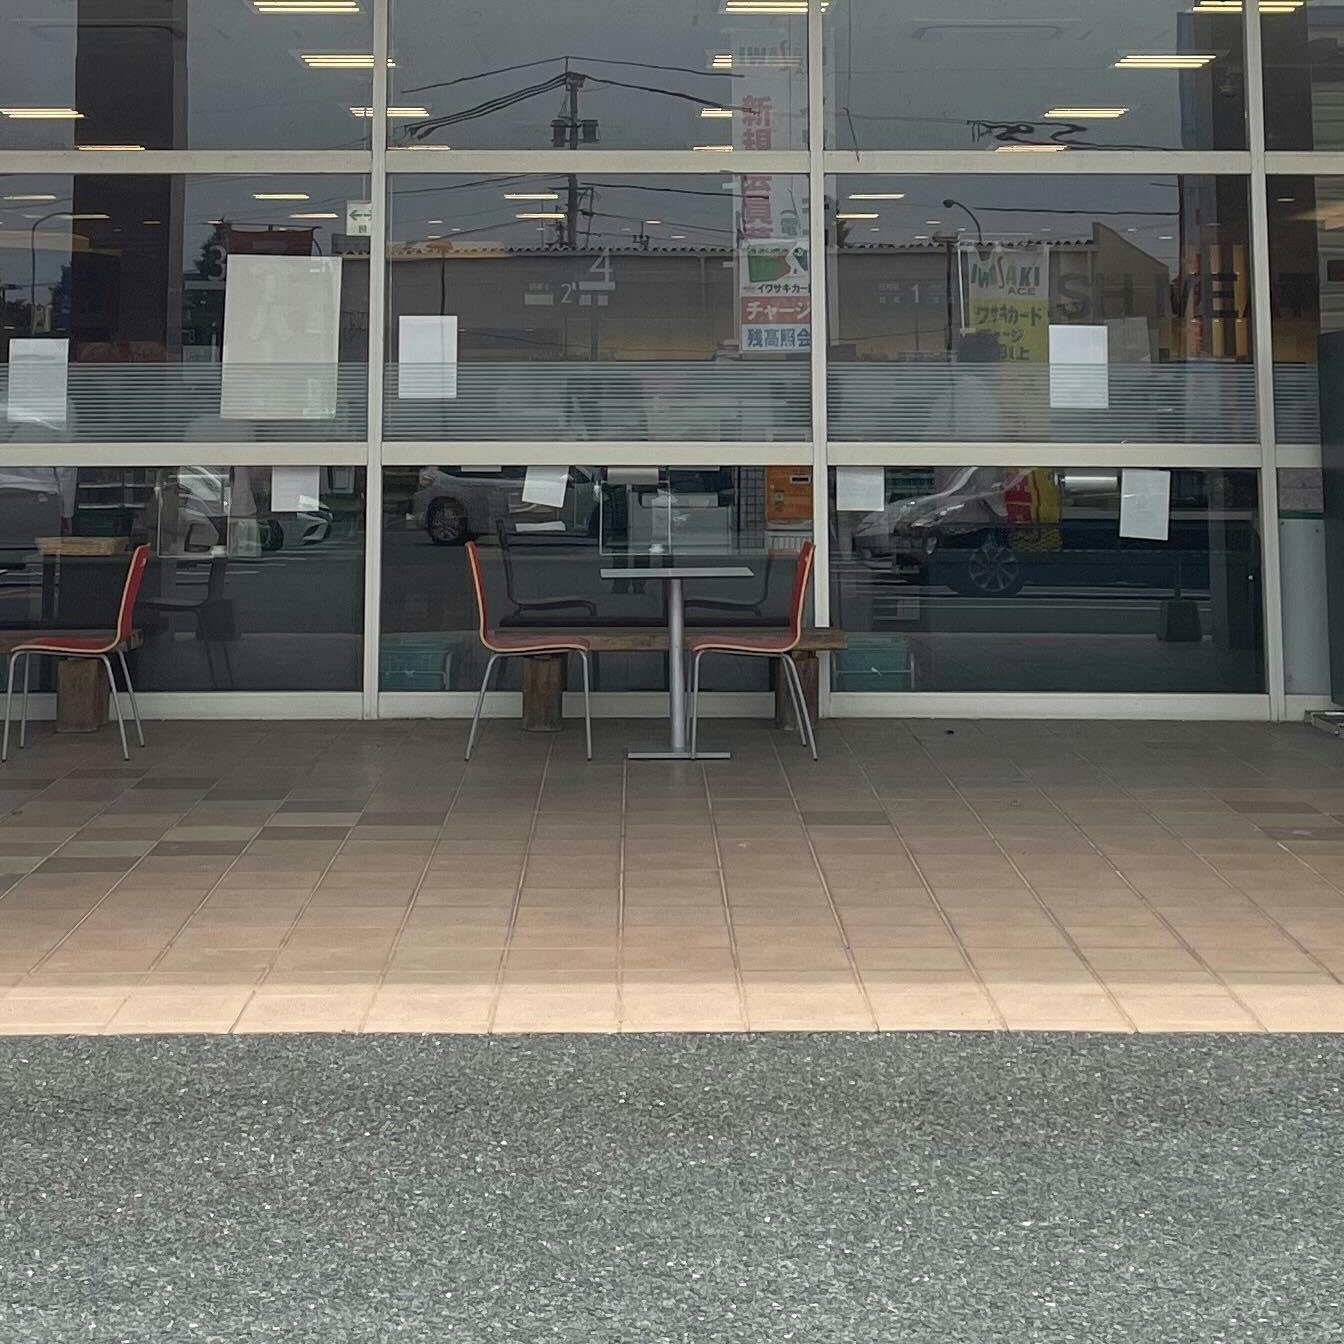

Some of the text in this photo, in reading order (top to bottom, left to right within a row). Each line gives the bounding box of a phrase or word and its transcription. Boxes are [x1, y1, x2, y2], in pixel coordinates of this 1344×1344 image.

[757, 283, 811, 294] イワサキカー
